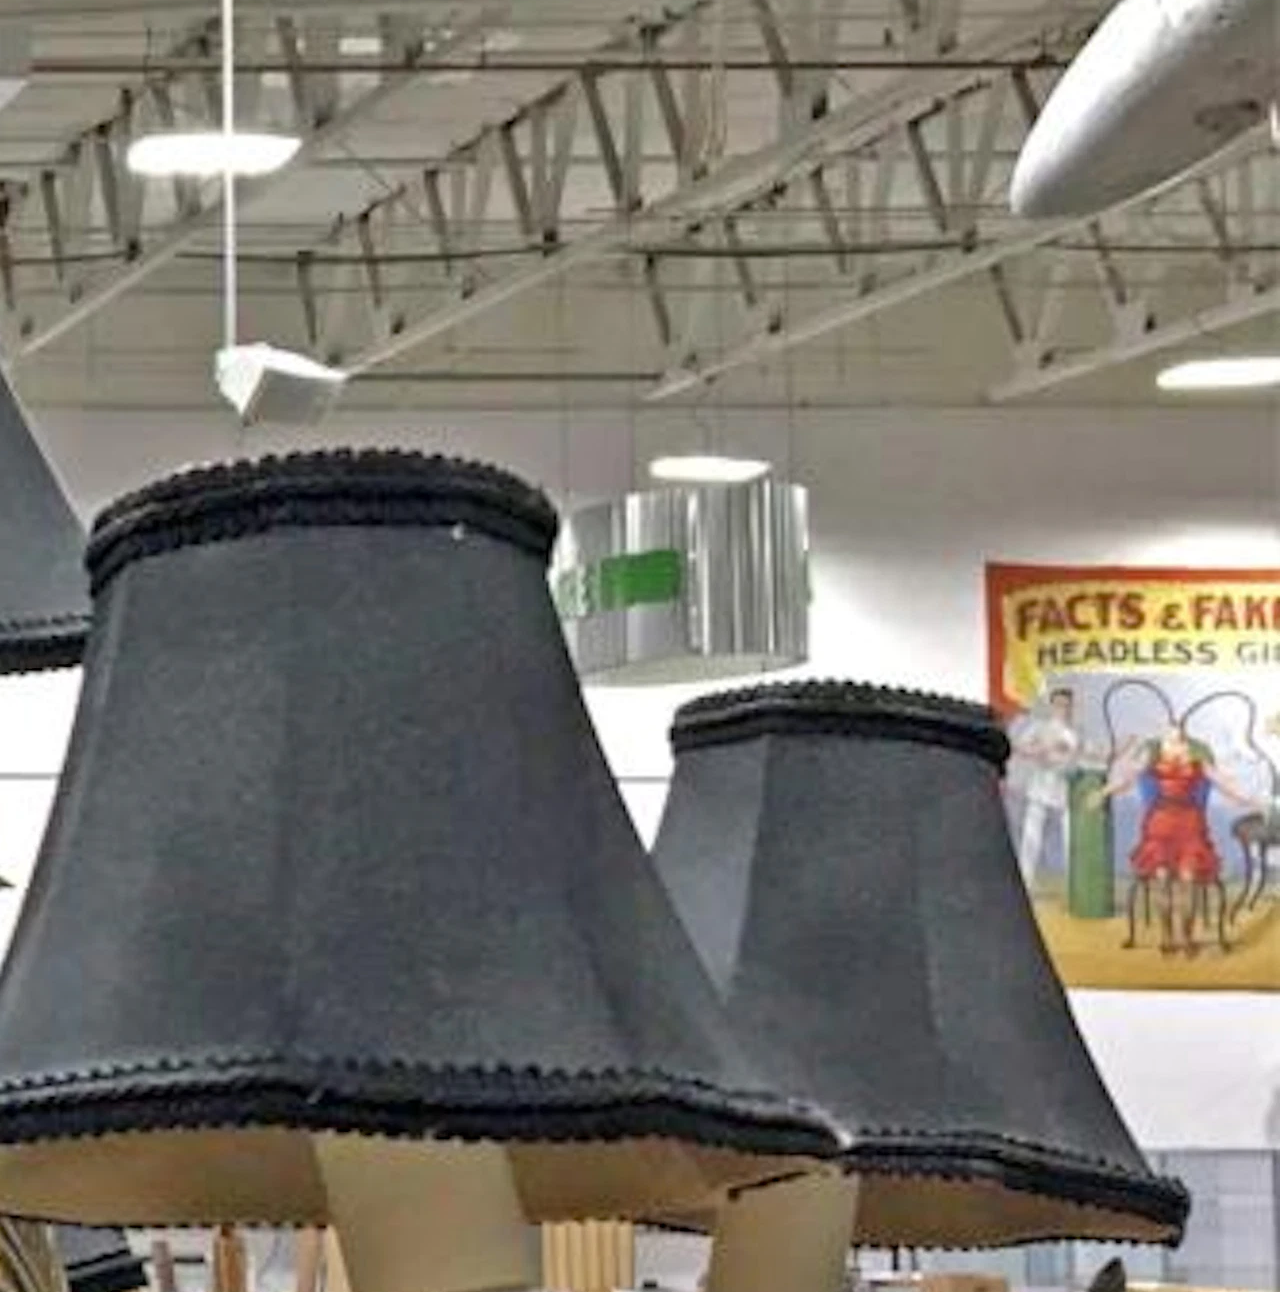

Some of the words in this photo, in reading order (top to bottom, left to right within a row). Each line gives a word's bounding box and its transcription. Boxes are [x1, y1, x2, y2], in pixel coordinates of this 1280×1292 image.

[1016, 591, 1146, 641] FACTS
[1161, 603, 1186, 631] &
[1037, 639, 1219, 667] HEADLESS
